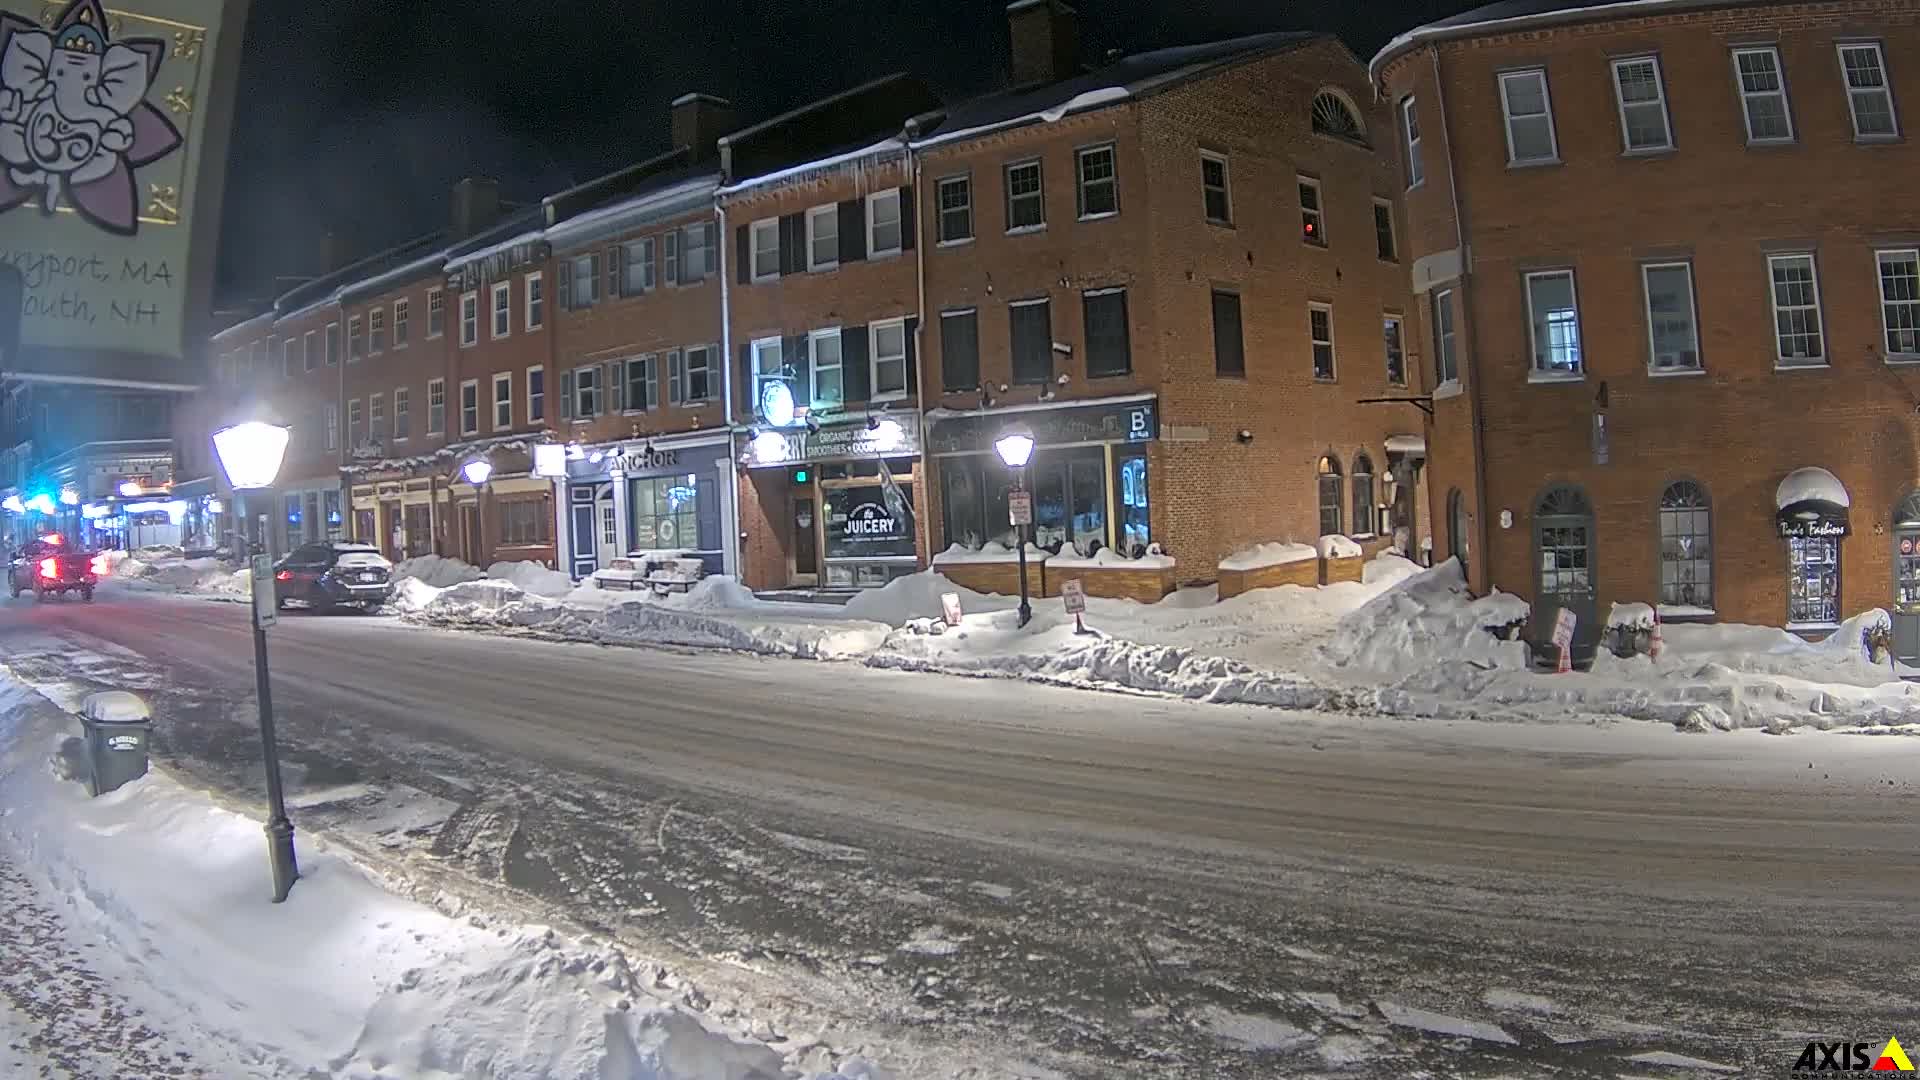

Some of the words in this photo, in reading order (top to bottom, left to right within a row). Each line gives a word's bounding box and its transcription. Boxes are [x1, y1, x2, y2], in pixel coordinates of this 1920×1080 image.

[120, 258, 174, 287] MA
[110, 300, 162, 326] NH
[1131, 411, 1145, 431] B
[610, 450, 678, 471] ANCHOR
[843, 519, 895, 534] JUICERY
